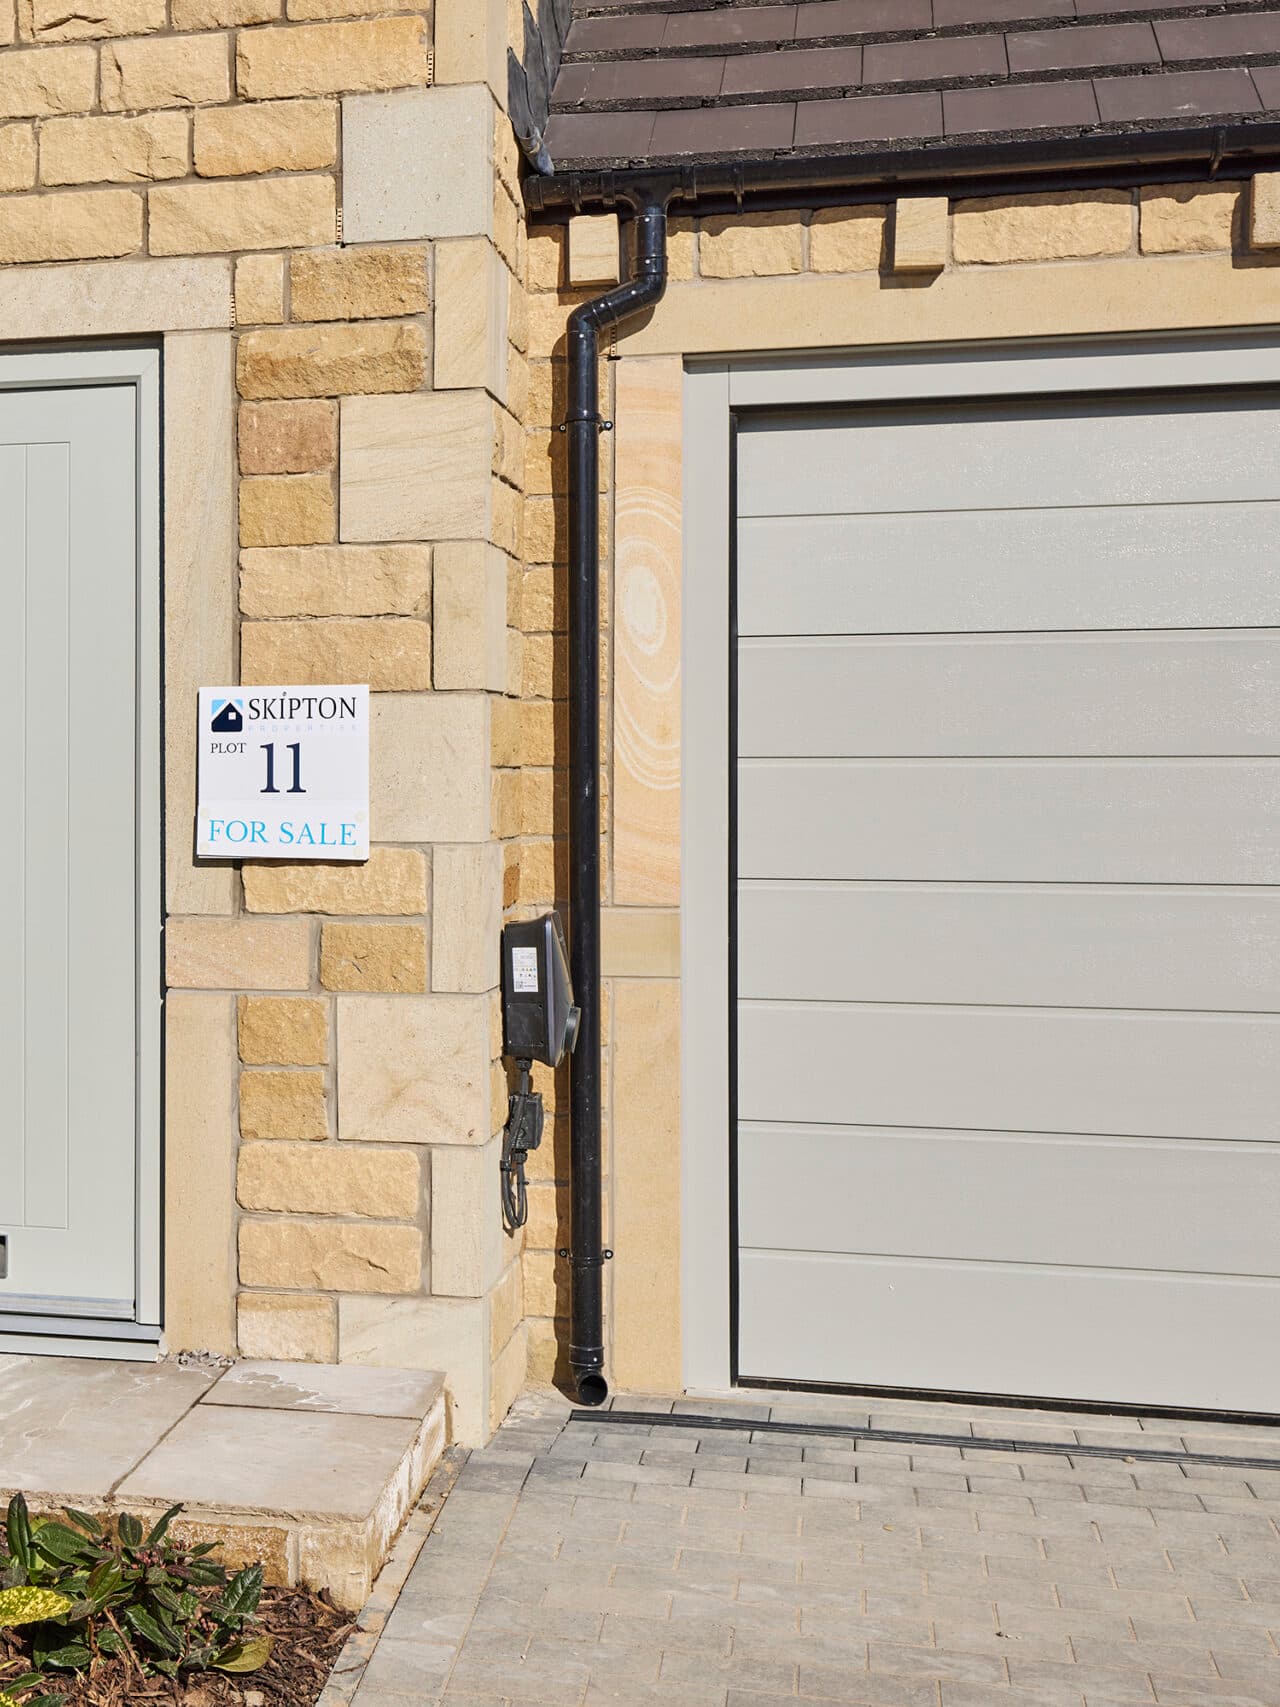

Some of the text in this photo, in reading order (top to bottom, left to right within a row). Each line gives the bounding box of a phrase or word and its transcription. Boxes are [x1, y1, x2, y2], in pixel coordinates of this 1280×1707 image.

[248, 696, 357, 720] SKIPTON
[210, 742, 307, 793] PLOT 11
[208, 819, 357, 846] FOR SALE
